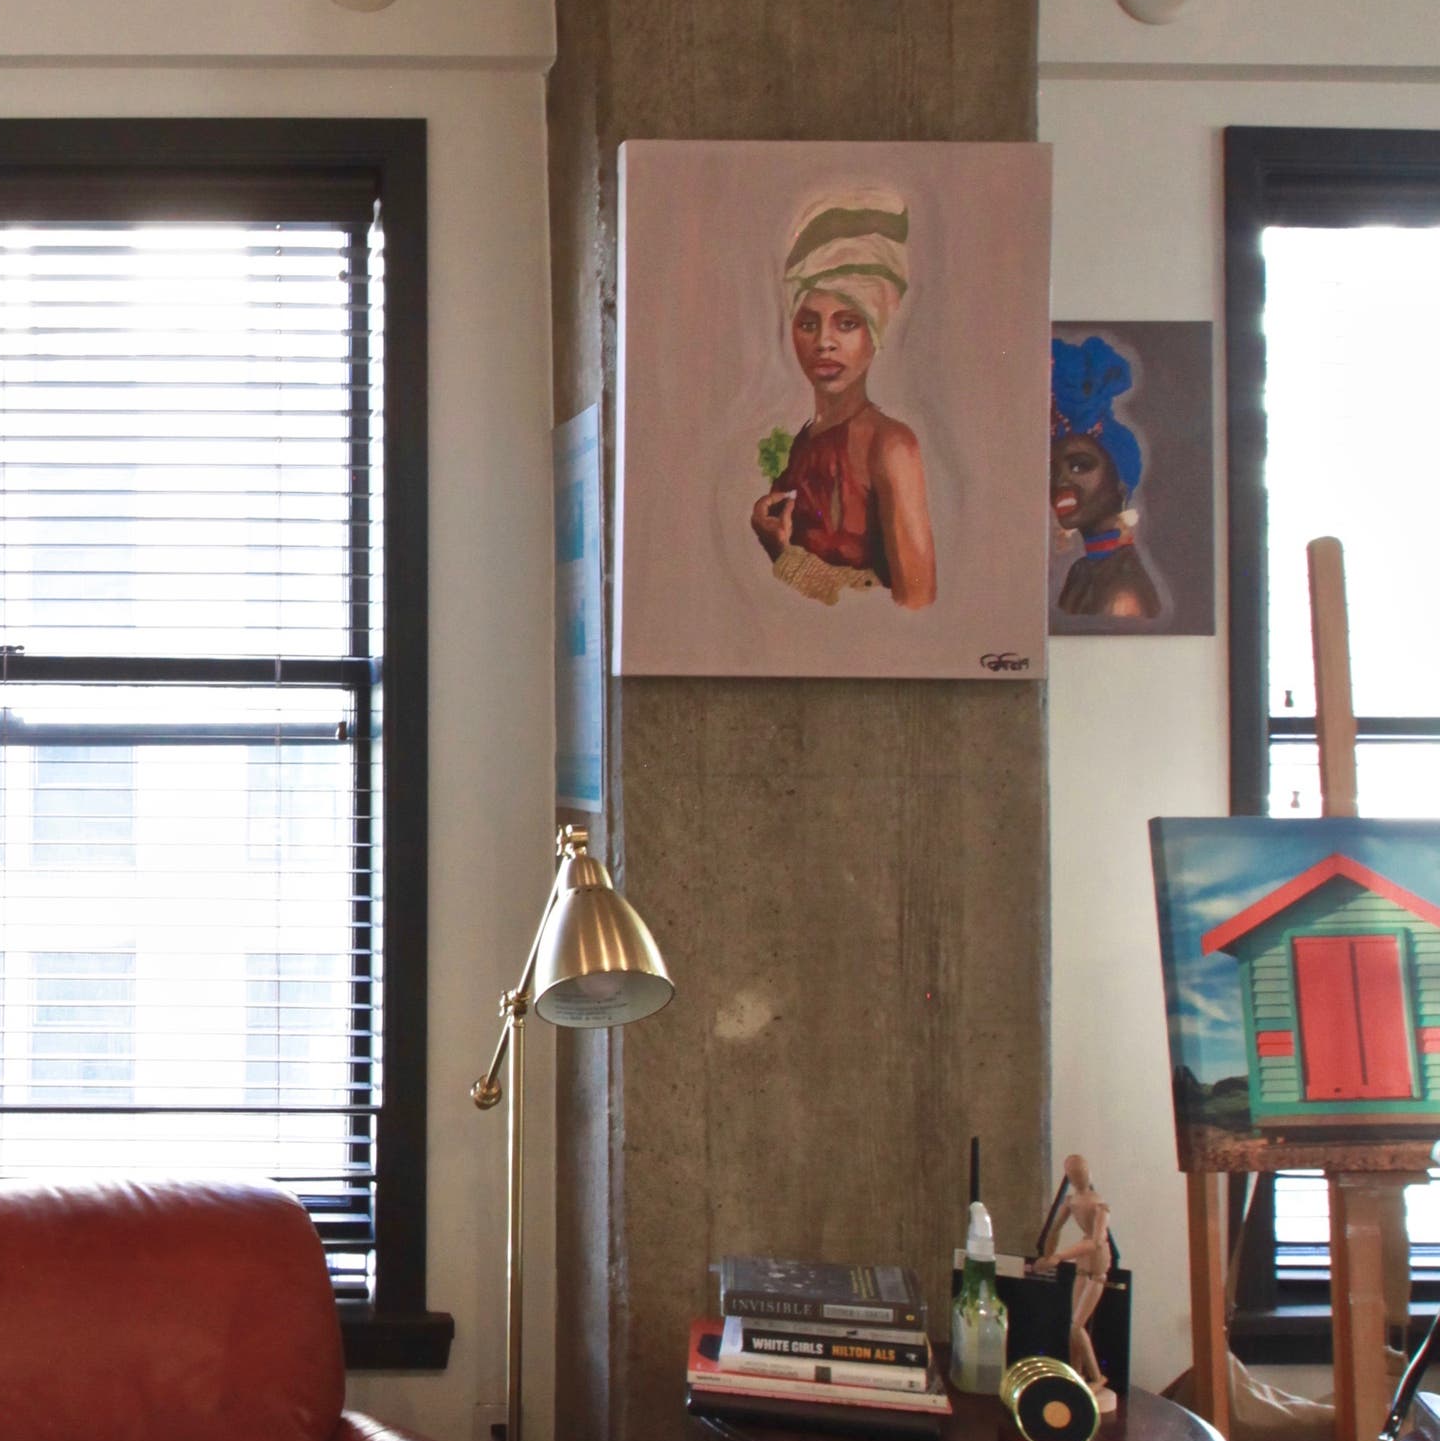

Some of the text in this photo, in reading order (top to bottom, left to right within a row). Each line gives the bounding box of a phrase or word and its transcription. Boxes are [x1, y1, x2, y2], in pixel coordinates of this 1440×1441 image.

[731, 1298, 813, 1316] INVISIBLE
[752, 1337, 789, 1353] WHITE
[791, 1340, 824, 1355] GIRLS
[832, 1345, 872, 1360] HILTON
[874, 1347, 896, 1361] ALS
